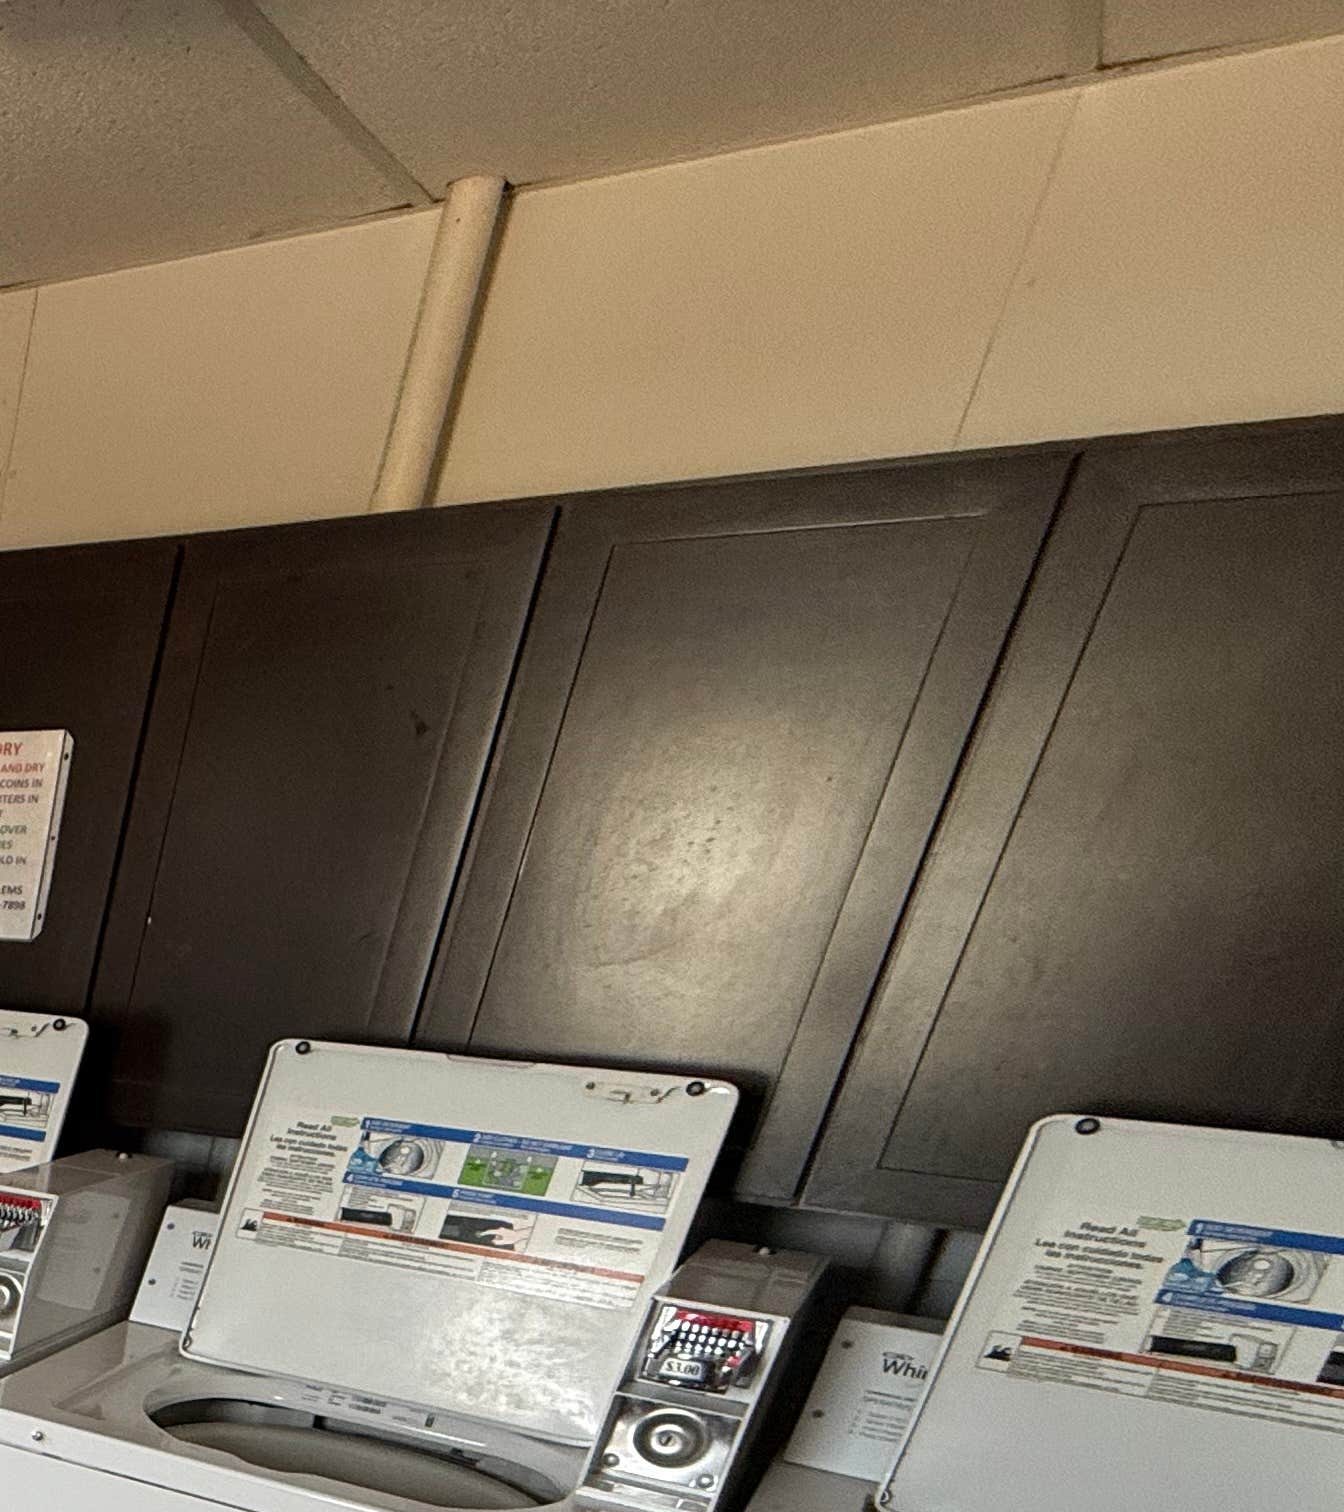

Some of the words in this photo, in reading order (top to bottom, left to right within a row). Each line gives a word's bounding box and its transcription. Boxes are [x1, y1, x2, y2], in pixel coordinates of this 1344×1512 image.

[0, 763, 23, 774] AND
[25, 763, 44, 773] DRY
[0, 779, 30, 789] COINS
[31, 778, 43, 788] IN
[27, 794, 39, 804] IN
[0, 825, 28, 835] OVER
[15, 856, 27, 865] IN
